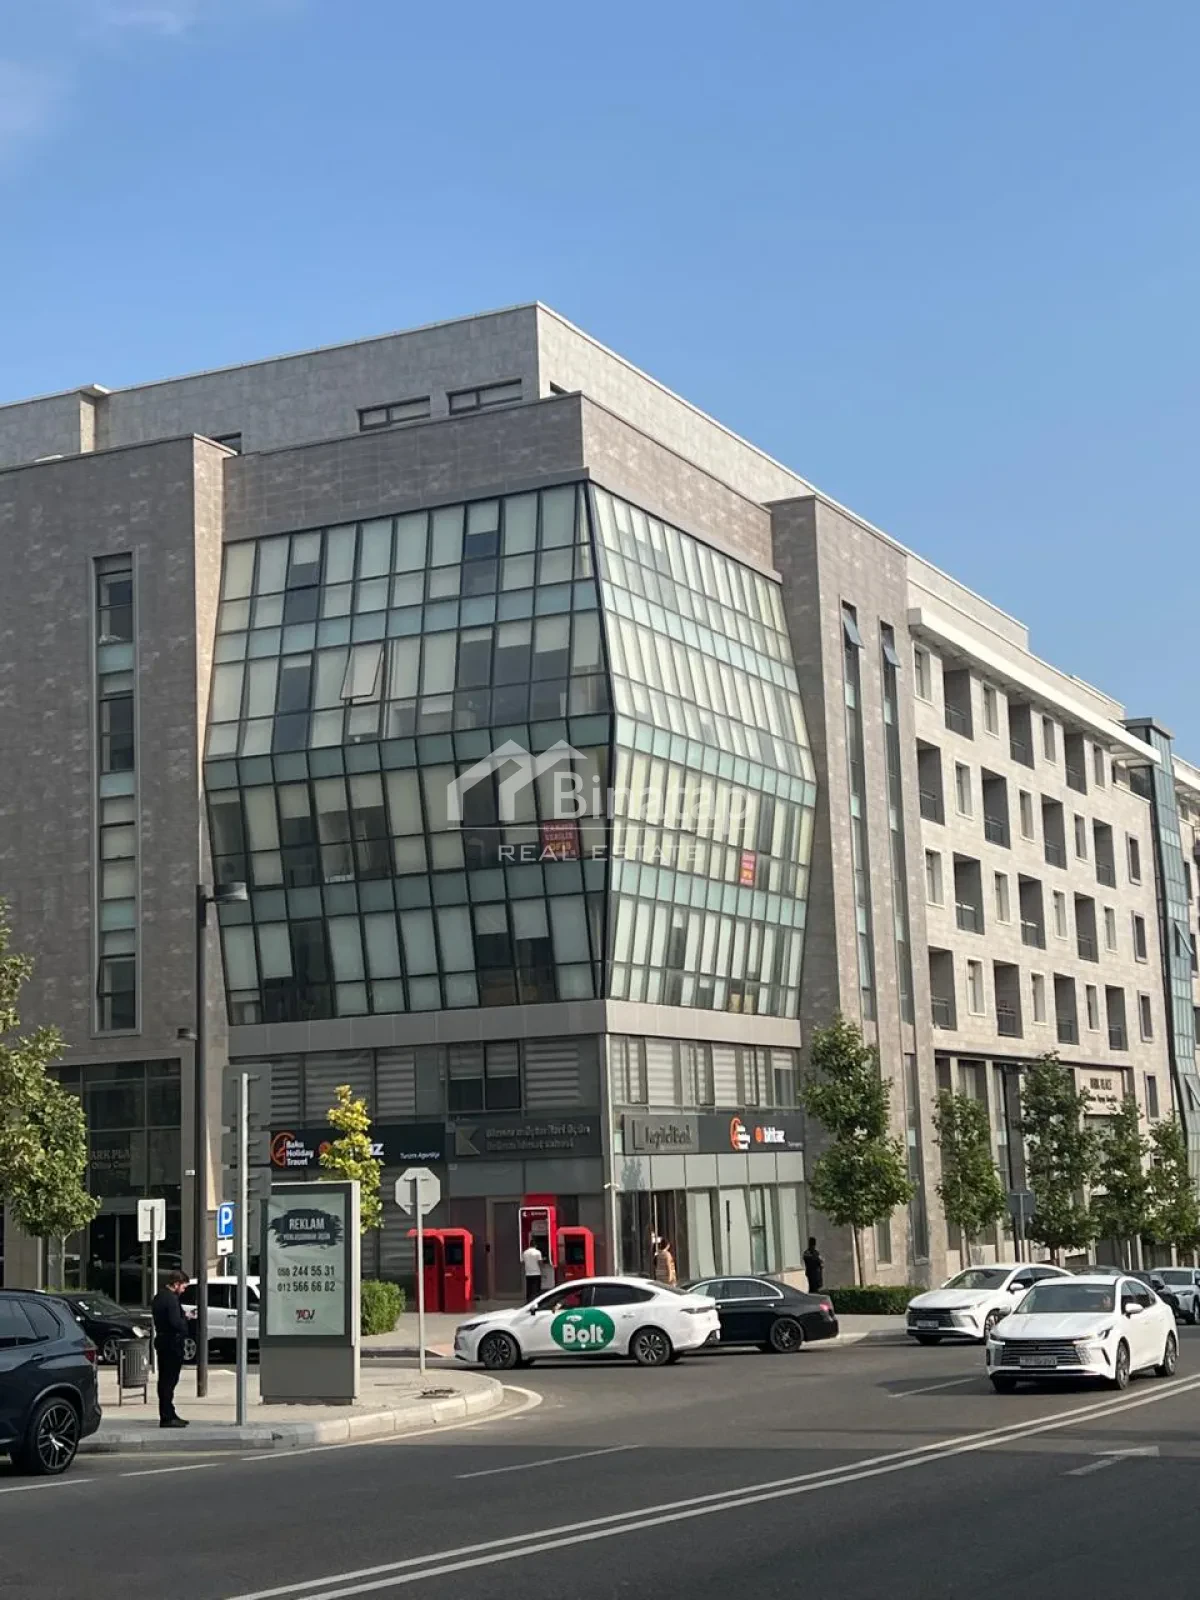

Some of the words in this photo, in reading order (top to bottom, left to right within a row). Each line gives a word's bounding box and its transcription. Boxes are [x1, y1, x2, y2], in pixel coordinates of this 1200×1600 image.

[286, 1149, 315, 1159] Holiday
[286, 1157, 309, 1166] Travel
[221, 1206, 233, 1234] P
[289, 1218, 325, 1231] REKLAM
[292, 1265, 309, 1277] 244
[311, 1265, 322, 1277] 55
[324, 1265, 335, 1277] 31
[277, 1282, 291, 1292] 012
[293, 1280, 309, 1292] 566
[311, 1280, 322, 1292] 66
[562, 1323, 604, 1344] Bolt
